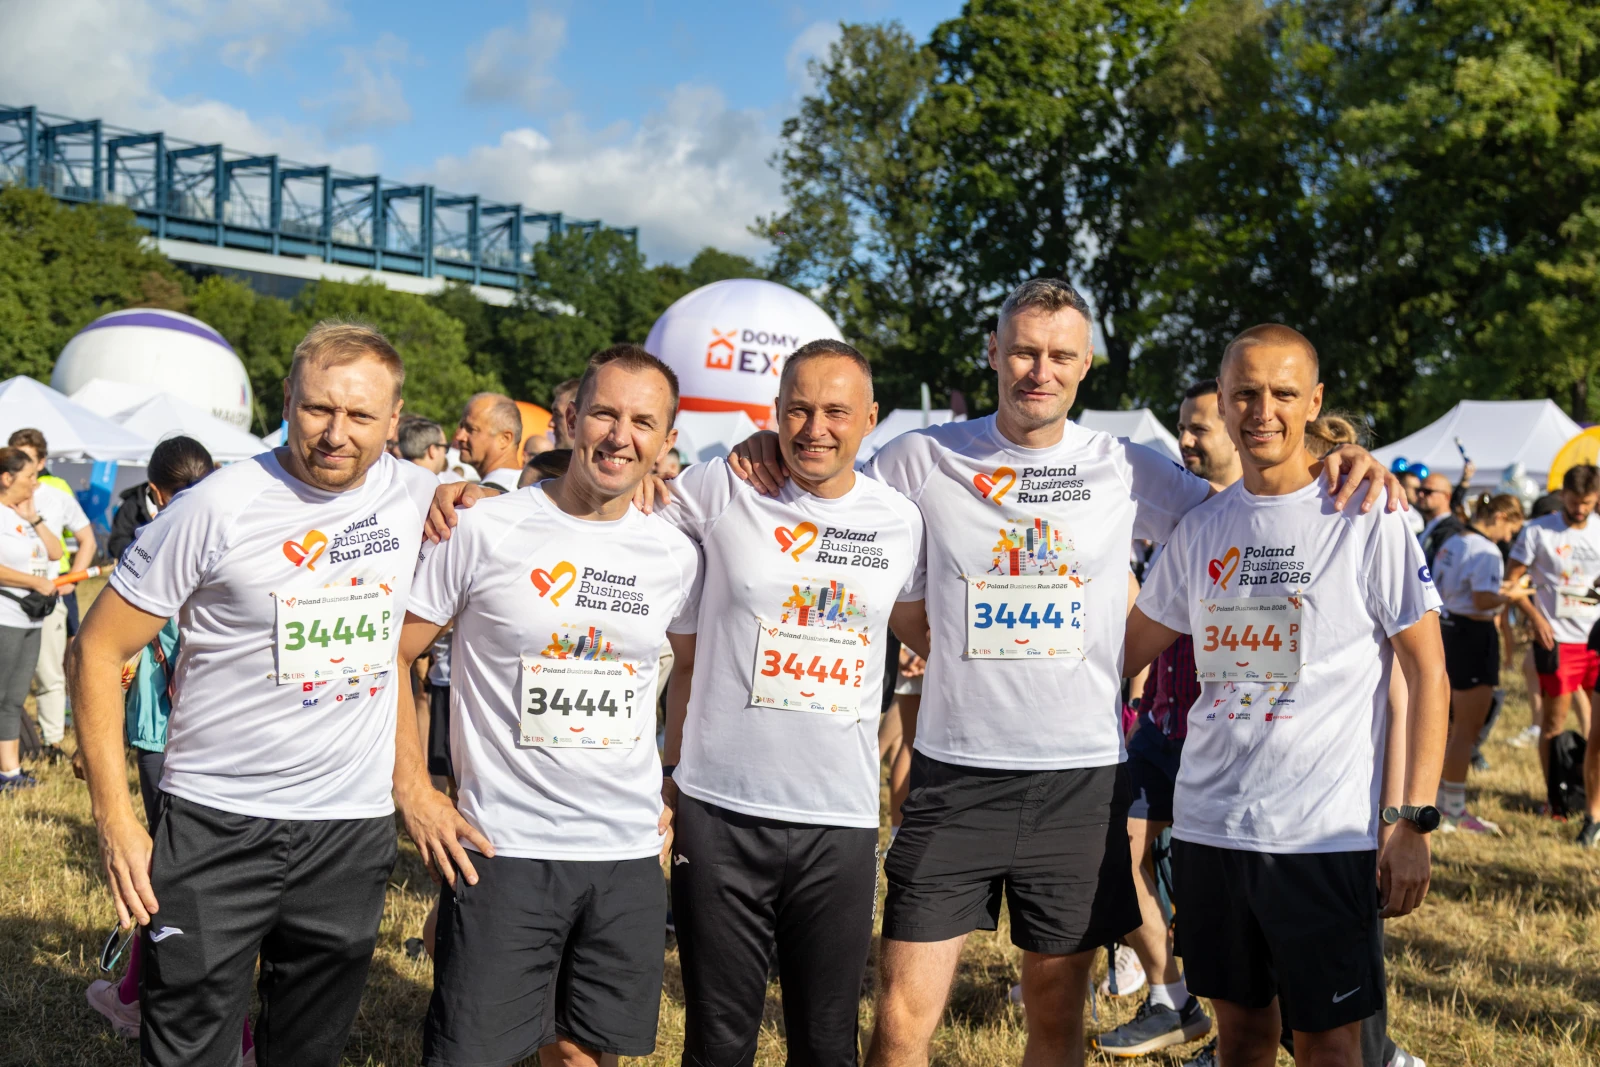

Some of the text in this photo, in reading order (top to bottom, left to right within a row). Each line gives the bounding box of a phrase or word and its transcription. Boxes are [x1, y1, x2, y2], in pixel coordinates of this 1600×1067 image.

[742, 330, 799, 348] DOMY
[1022, 465, 1076, 478] Poland
[1020, 478, 1084, 490] Business
[1017, 490, 1091, 503] Run 2026
[336, 514, 378, 536] oland
[331, 528, 390, 549] Business
[822, 527, 877, 542] Poland
[134, 546, 152, 563] HSBC
[330, 546, 361, 564] Run
[365, 538, 400, 556] 2026
[820, 540, 883, 556] Business
[1244, 546, 1295, 559] Poland
[815, 551, 889, 569] Run 2026
[1241, 560, 1304, 572] Business
[582, 567, 636, 587] Poland
[1238, 572, 1311, 586] Run 2026
[579, 581, 643, 602] Business
[575, 595, 649, 616] Run 2026
[1072, 602, 1081, 613] P
[382, 611, 390, 624] P
[974, 602, 1064, 629] 3444
[1071, 617, 1080, 629] 4
[1290, 624, 1298, 636] P
[285, 615, 376, 651] 3444
[382, 627, 389, 640] 5
[778, 631, 801, 640] Poland
[1203, 625, 1282, 651] 3444
[1290, 640, 1297, 652] 3
[760, 650, 848, 685] 3444
[856, 660, 864, 671] P
[854, 675, 862, 687] 2
[527, 687, 618, 717] 3444
[625, 690, 634, 702] P
[626, 706, 631, 718] 1
